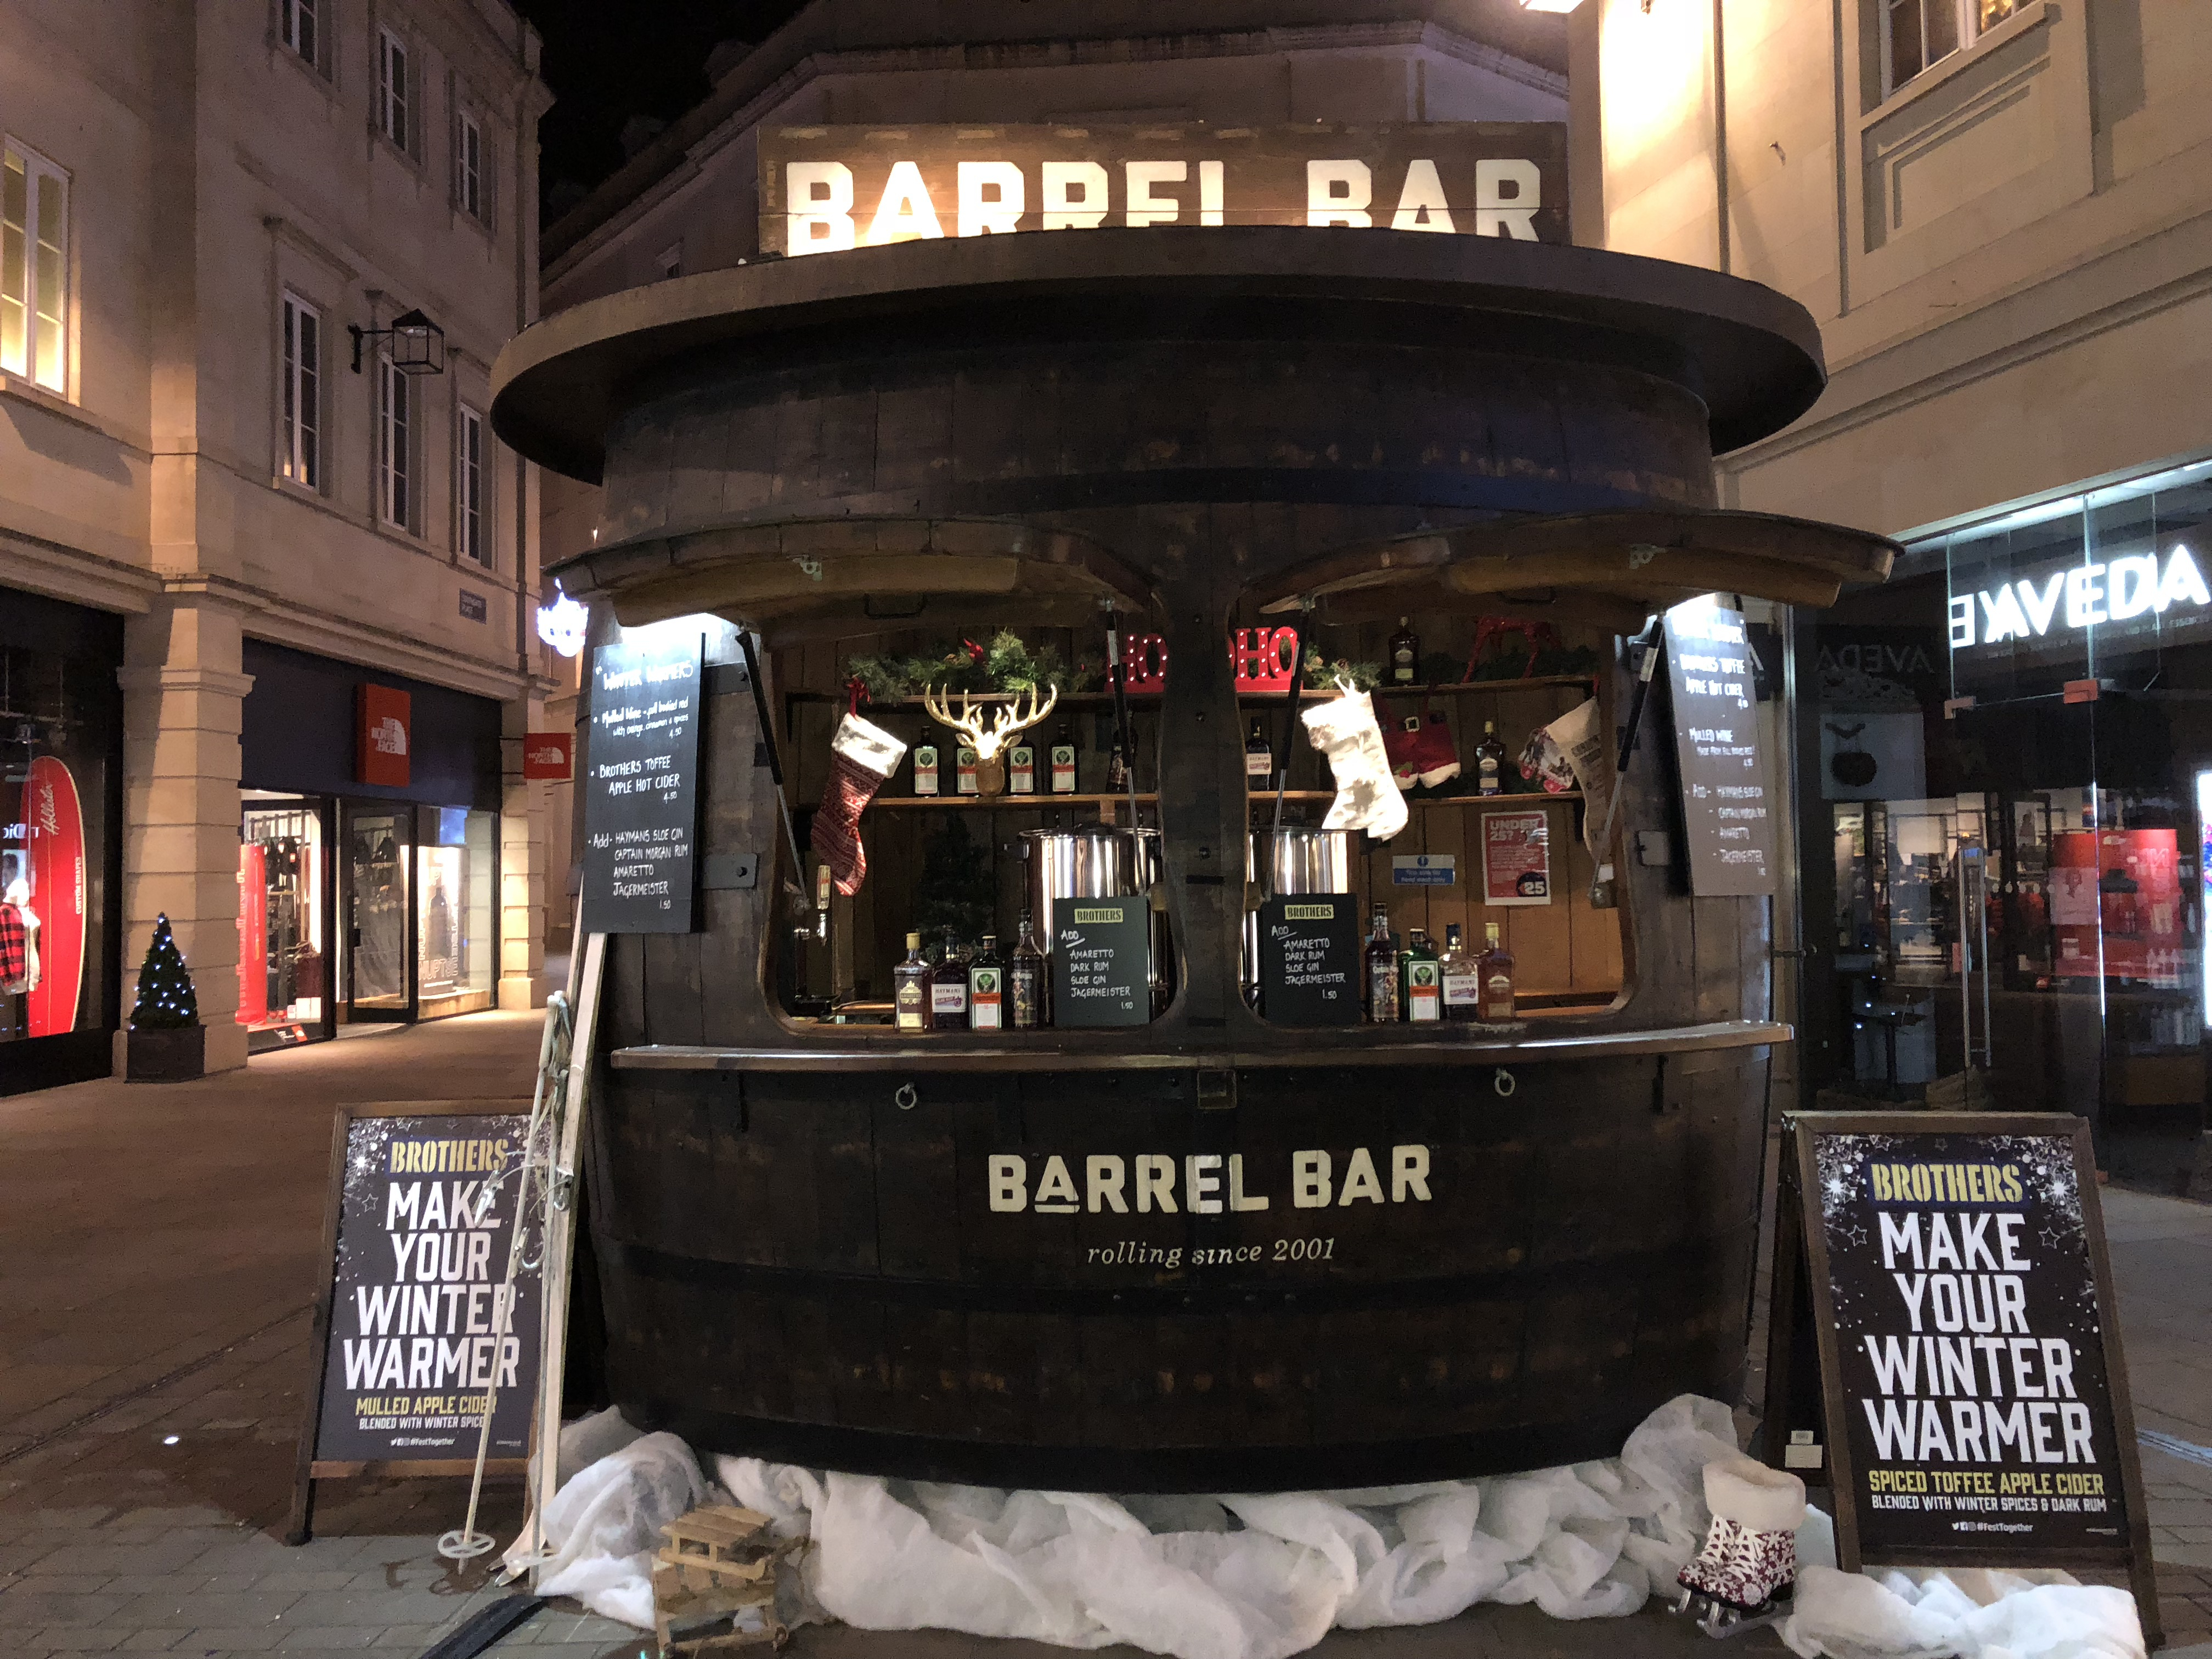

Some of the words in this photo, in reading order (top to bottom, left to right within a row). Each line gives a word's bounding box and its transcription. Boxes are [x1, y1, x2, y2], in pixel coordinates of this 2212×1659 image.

[1307, 159, 1541, 242] BAR
[1984, 544, 2211, 644] AVEDA
[600, 760, 641, 778] BROTHERS
[645, 755, 671, 771] TOFFEE
[608, 780, 632, 796] APPLE
[636, 778, 652, 792] HOT
[655, 774, 680, 788] CIDER
[616, 830, 650, 844] HAYMANS
[653, 828, 669, 842] SLOE
[671, 827, 683, 840] GIN
[614, 848, 643, 861] CAPTAIN
[645, 847, 671, 860] MORGAN
[674, 843, 688, 857] RUM
[613, 864, 654, 878] AMARETTO
[1524, 882, 1545, 895] 25
[1077, 910, 1121, 922] BROTHERS
[1287, 907, 1331, 917] BROTHERS
[1069, 949, 1114, 960] AMARETTO
[1283, 938, 1330, 951] AMARETTO
[1285, 952, 1306, 961] DARK
[1308, 950, 1325, 961] RUM
[1070, 962, 1090, 973] DARK
[1093, 961, 1109, 972] RUM
[1285, 963, 1303, 973] SLOE
[1307, 962, 1319, 973] GIN
[1070, 976, 1089, 985] SLOE
[1093, 975, 1107, 985] GIN
[1285, 973, 1346, 986] JAGERMEISTER
[1071, 986, 1131, 999] JAGERMEISTER
[390, 1139, 509, 1173] BROTHERS
[988, 1153, 1269, 1214] BARREL
[1293, 1144, 1432, 1209] BAR
[1871, 1163, 2023, 1203] BROTHERS
[1878, 1211, 2031, 1271] MAKE
[391, 1232, 492, 1283] YOUR
[1087, 1242, 1183, 1269] rolling
[1192, 1244, 1262, 1265] since
[1273, 1237, 1336, 1261] 2001
[357, 1284, 517, 1336] WINTER
[1893, 1273, 2030, 1334] YOUR
[343, 1337, 521, 1390] WARMER
[1864, 1335, 2078, 1398] WINTER
[356, 1397, 410, 1416] MULLED
[413, 1396, 456, 1414] APPLE
[459, 1396, 497, 1414] CIDE
[359, 1417, 397, 1430] BLENDED
[399, 1417, 422, 1429] WITH
[425, 1416, 459, 1429] WINTER
[1861, 1399, 2097, 1464] WARMER
[1869, 1470, 1927, 1493] SPICED
[1931, 1471, 1995, 1493] TOFFEE
[2000, 1472, 2053, 1494] APPLE
[2056, 1474, 2104, 1495] CIDER
[1871, 1494, 1920, 1509] BLENDED
[1922, 1496, 1951, 1511] WITH
[1954, 1496, 1998, 1511] WINTER
[2001, 1497, 2038, 1511] SPICES
[2040, 1498, 2049, 1512] &
[2051, 1498, 2081, 1512] DARK
[2083, 1498, 2107, 1513] RUM
